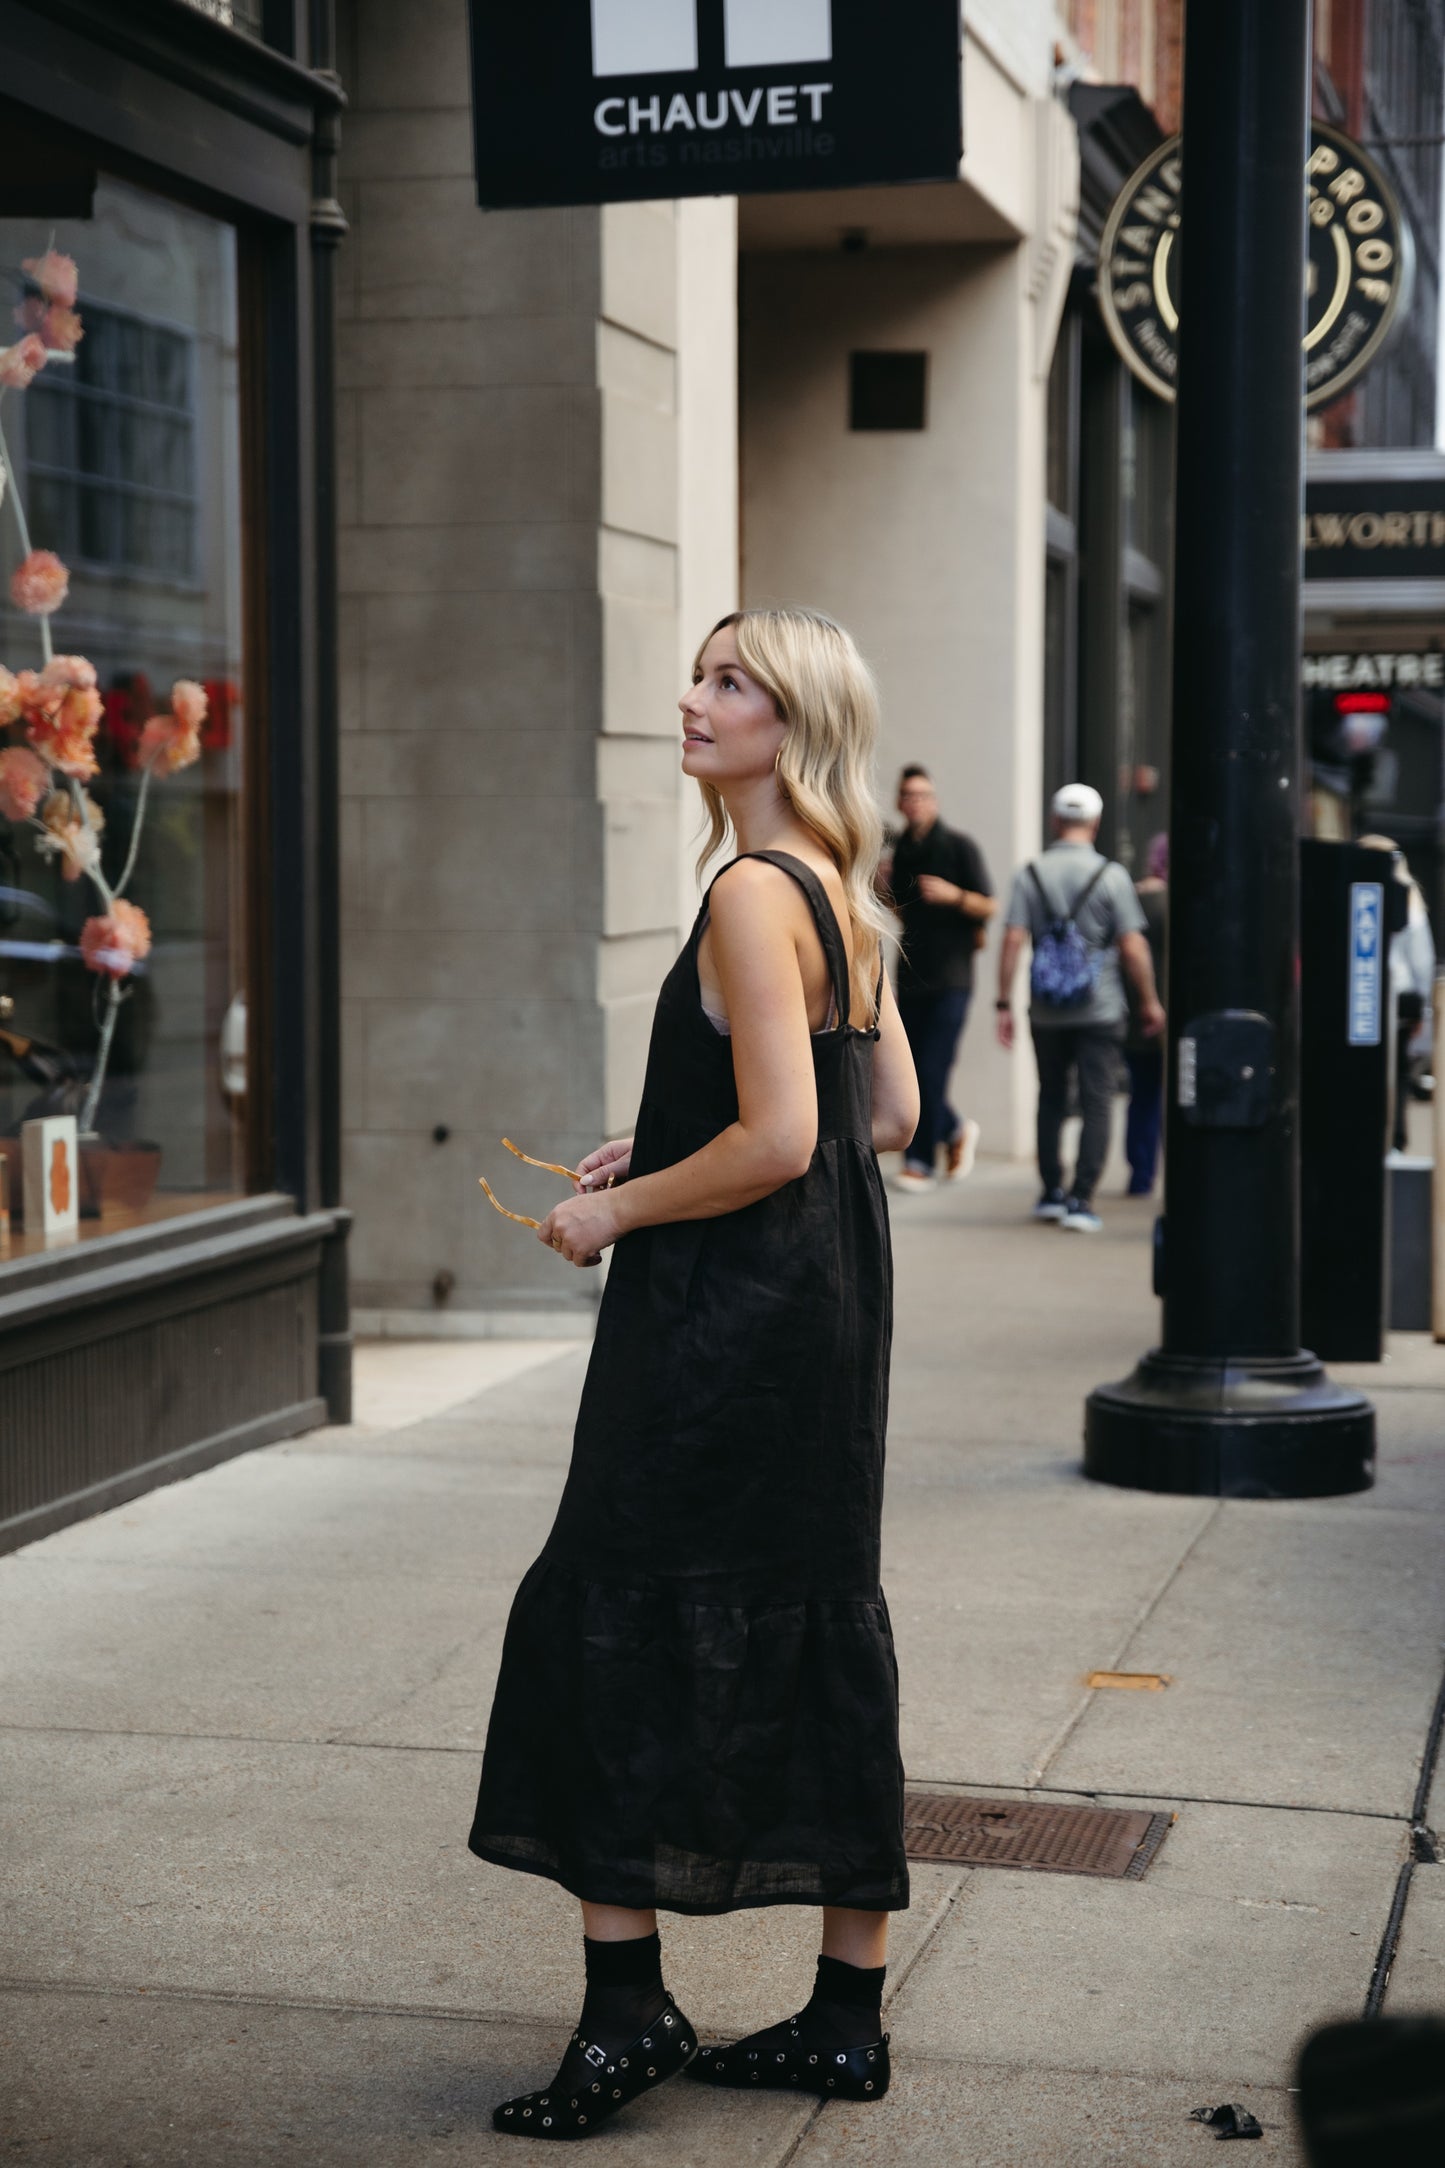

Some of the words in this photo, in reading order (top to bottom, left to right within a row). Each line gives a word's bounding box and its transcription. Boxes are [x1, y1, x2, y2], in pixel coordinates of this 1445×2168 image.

[592, 82, 834, 136] CHAUVET
[597, 137, 669, 170] arts
[679, 126, 837, 165] nashville
[1303, 511, 1445, 549] LWORT
[1301, 652, 1444, 688] HEATRE
